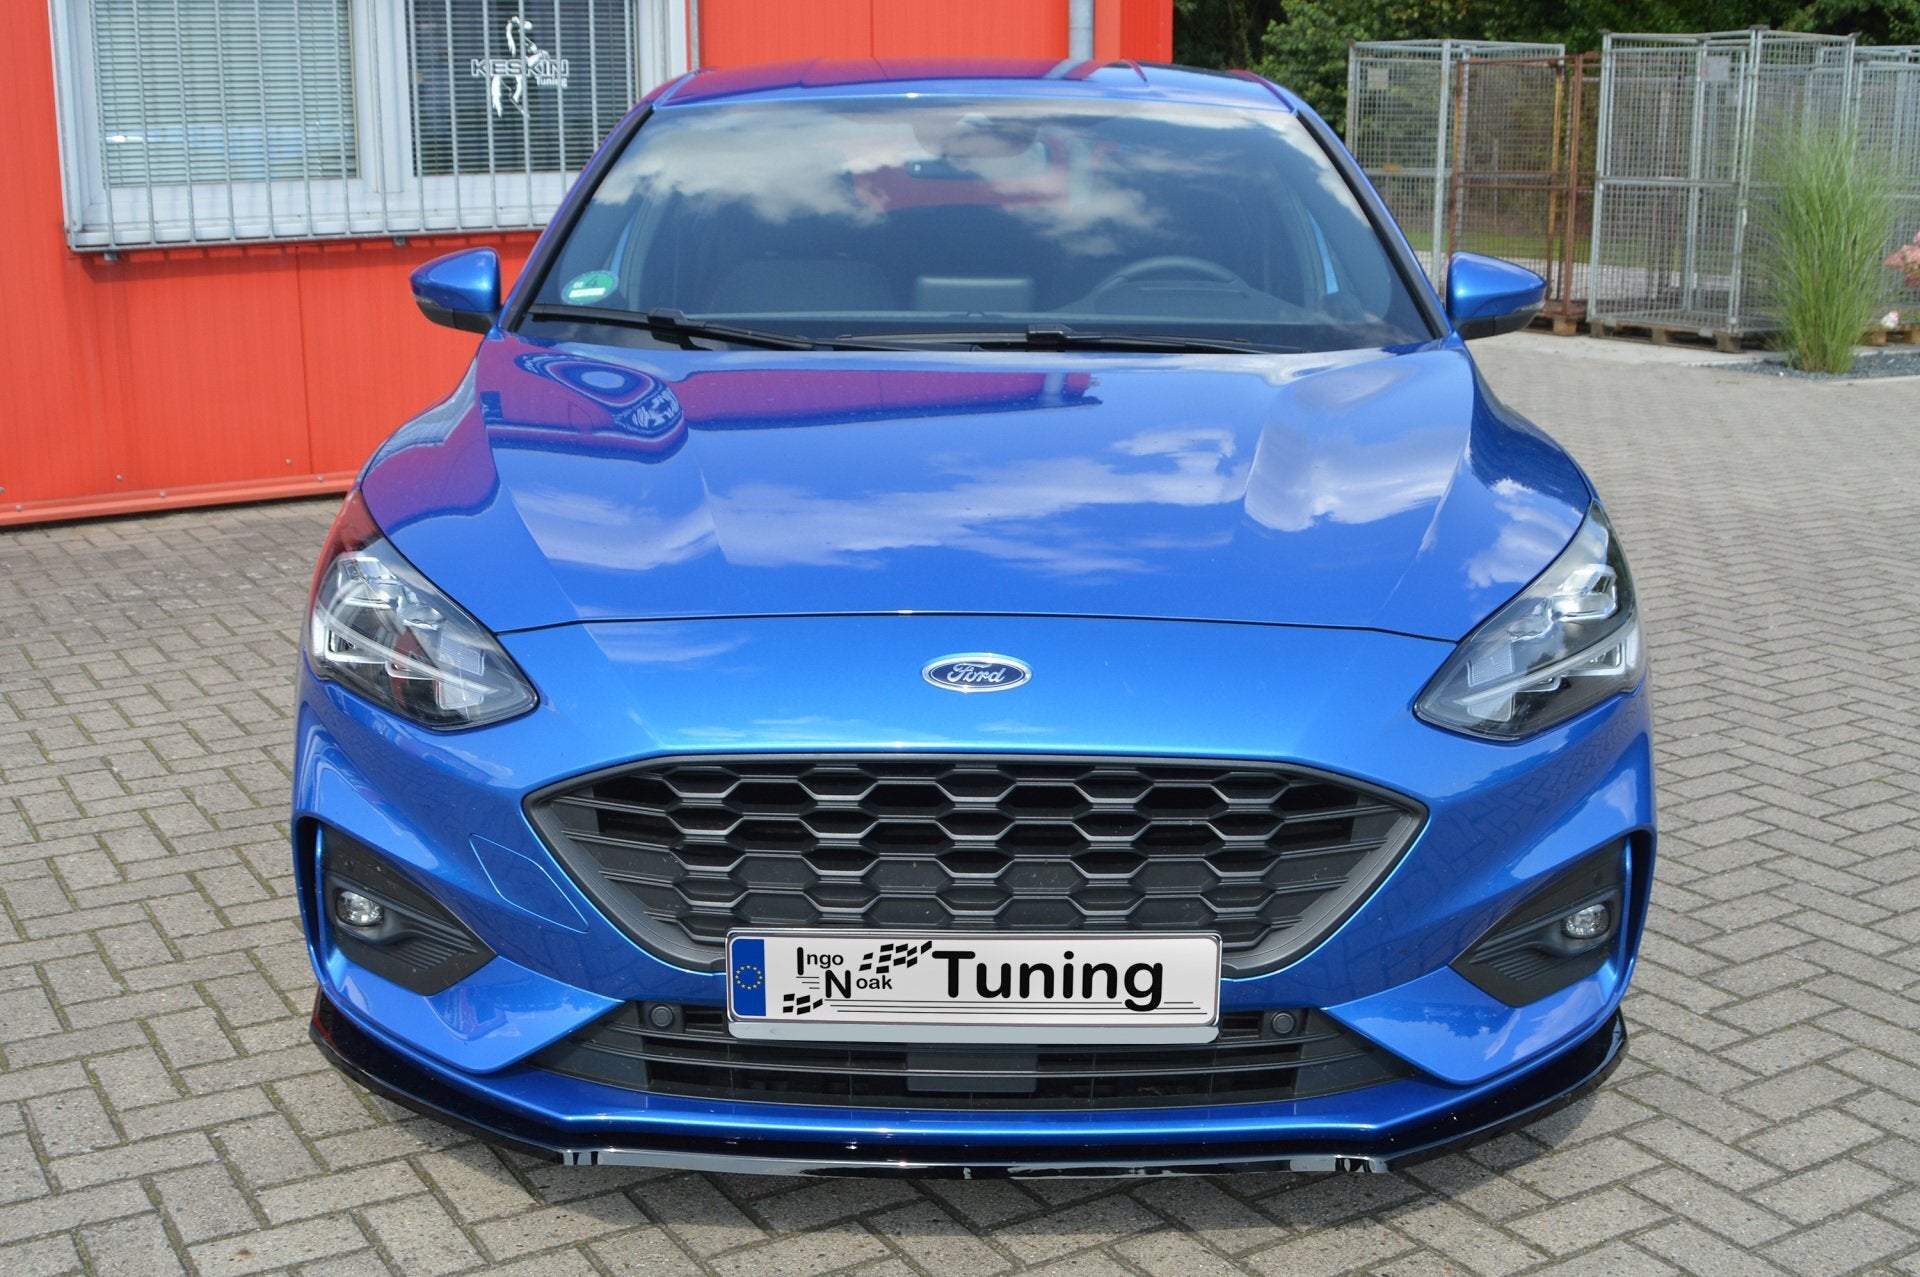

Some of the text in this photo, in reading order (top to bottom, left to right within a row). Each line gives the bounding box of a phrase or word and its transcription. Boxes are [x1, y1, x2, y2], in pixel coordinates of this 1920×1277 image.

[470, 58, 569, 77] KESKIN
[946, 662, 1007, 682] Ford
[796, 946, 844, 976] Ingo
[824, 950, 1163, 1012] Noak Tuning
